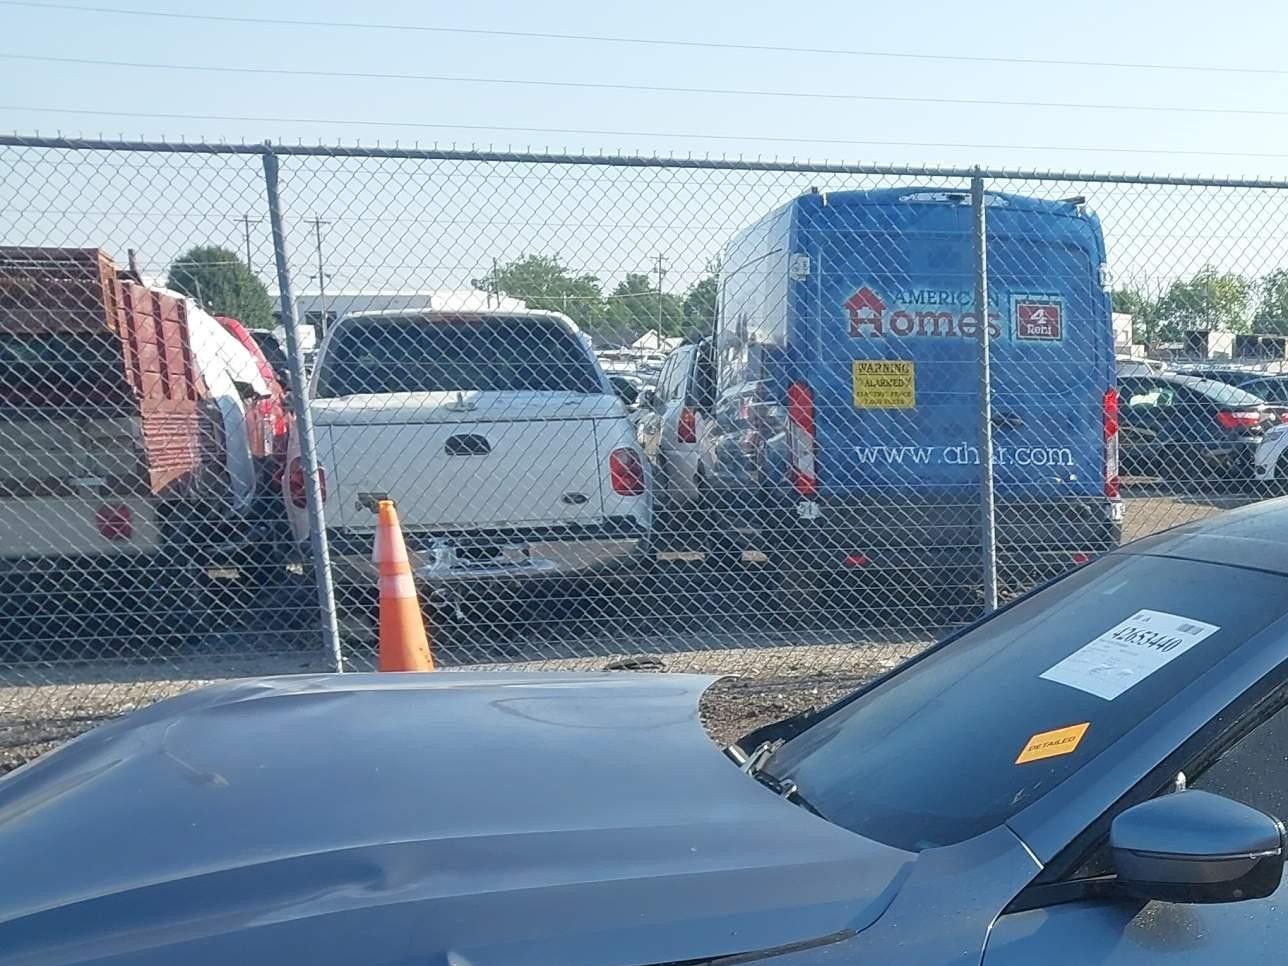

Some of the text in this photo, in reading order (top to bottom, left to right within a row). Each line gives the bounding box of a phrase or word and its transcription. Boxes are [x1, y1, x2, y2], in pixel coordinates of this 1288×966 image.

[893, 288, 999, 306] AMERICN
[1030, 309, 1048, 324] 4
[858, 362, 910, 374] WARNING
[856, 441, 1074, 466] www.ahr.com
[1111, 626, 1183, 653] 42653440
[1028, 735, 1076, 752] DETAILED
